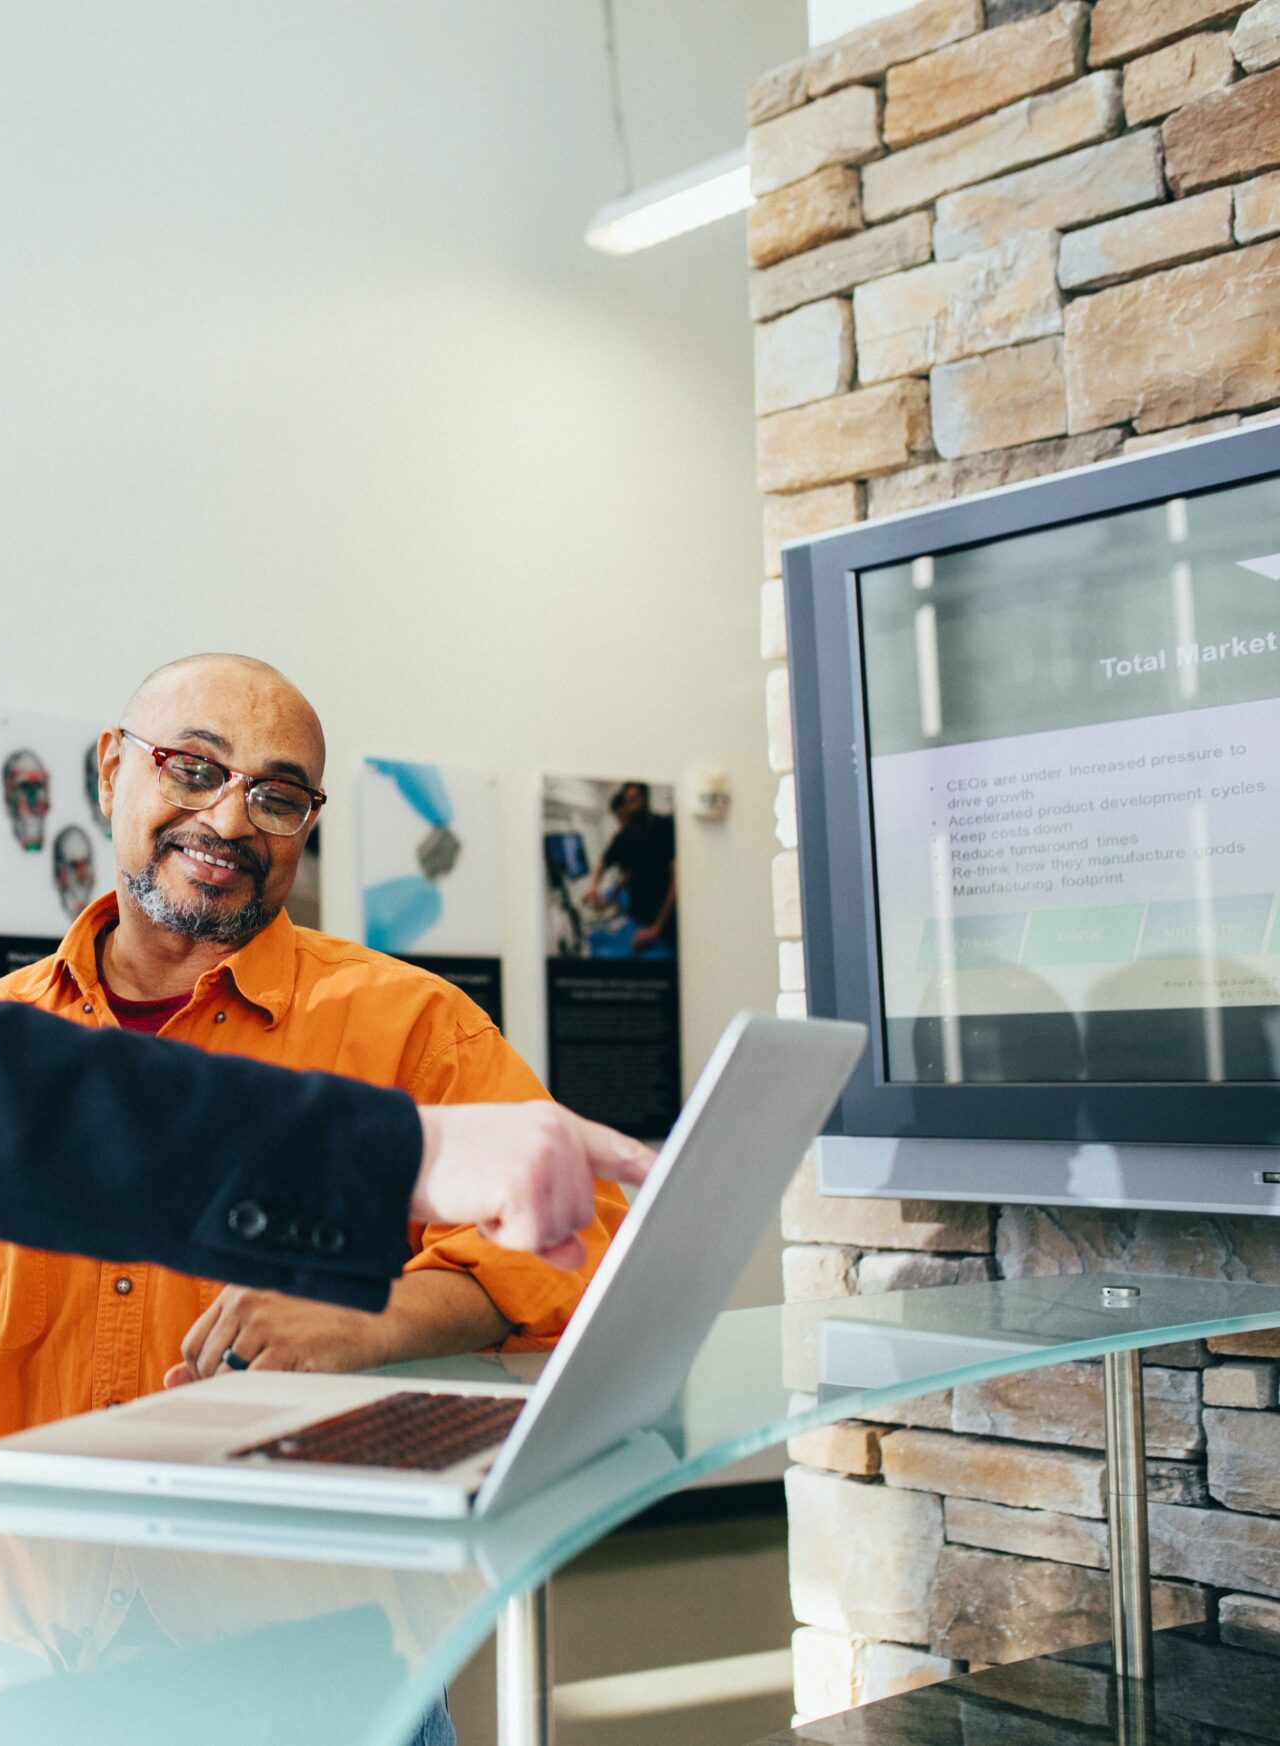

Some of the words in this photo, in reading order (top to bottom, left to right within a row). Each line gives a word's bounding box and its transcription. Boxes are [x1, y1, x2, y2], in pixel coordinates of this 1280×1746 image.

[1099, 650, 1166, 678] Total
[1176, 631, 1278, 667] Market
[946, 776, 988, 793] CEOs
[993, 772, 1017, 786] are
[1021, 767, 1062, 783] under
[1069, 756, 1146, 777] increased
[1150, 746, 1223, 769] pressure
[1229, 743, 1247, 756] to
[947, 794, 982, 810] drive
[986, 789, 1034, 808] growth
[948, 807, 1033, 828] Accelerated
[1038, 800, 1094, 820] product
[1100, 787, 1202, 811] development
[1210, 780, 1266, 800] cycles
[949, 830, 986, 846] Keep
[991, 824, 1030, 840] costs
[1033, 820, 1073, 836] down
[951, 846, 1005, 862] Reduce
[1009, 838, 1088, 857] turnaround
[1096, 832, 1139, 848] times
[952, 862, 1010, 879] Re-think
[1015, 859, 1046, 874] how
[1050, 855, 1083, 872] they
[1088, 846, 1185, 867] manufacture
[952, 877, 1053, 898] Manufacturing
[1061, 871, 1124, 889] footprint
